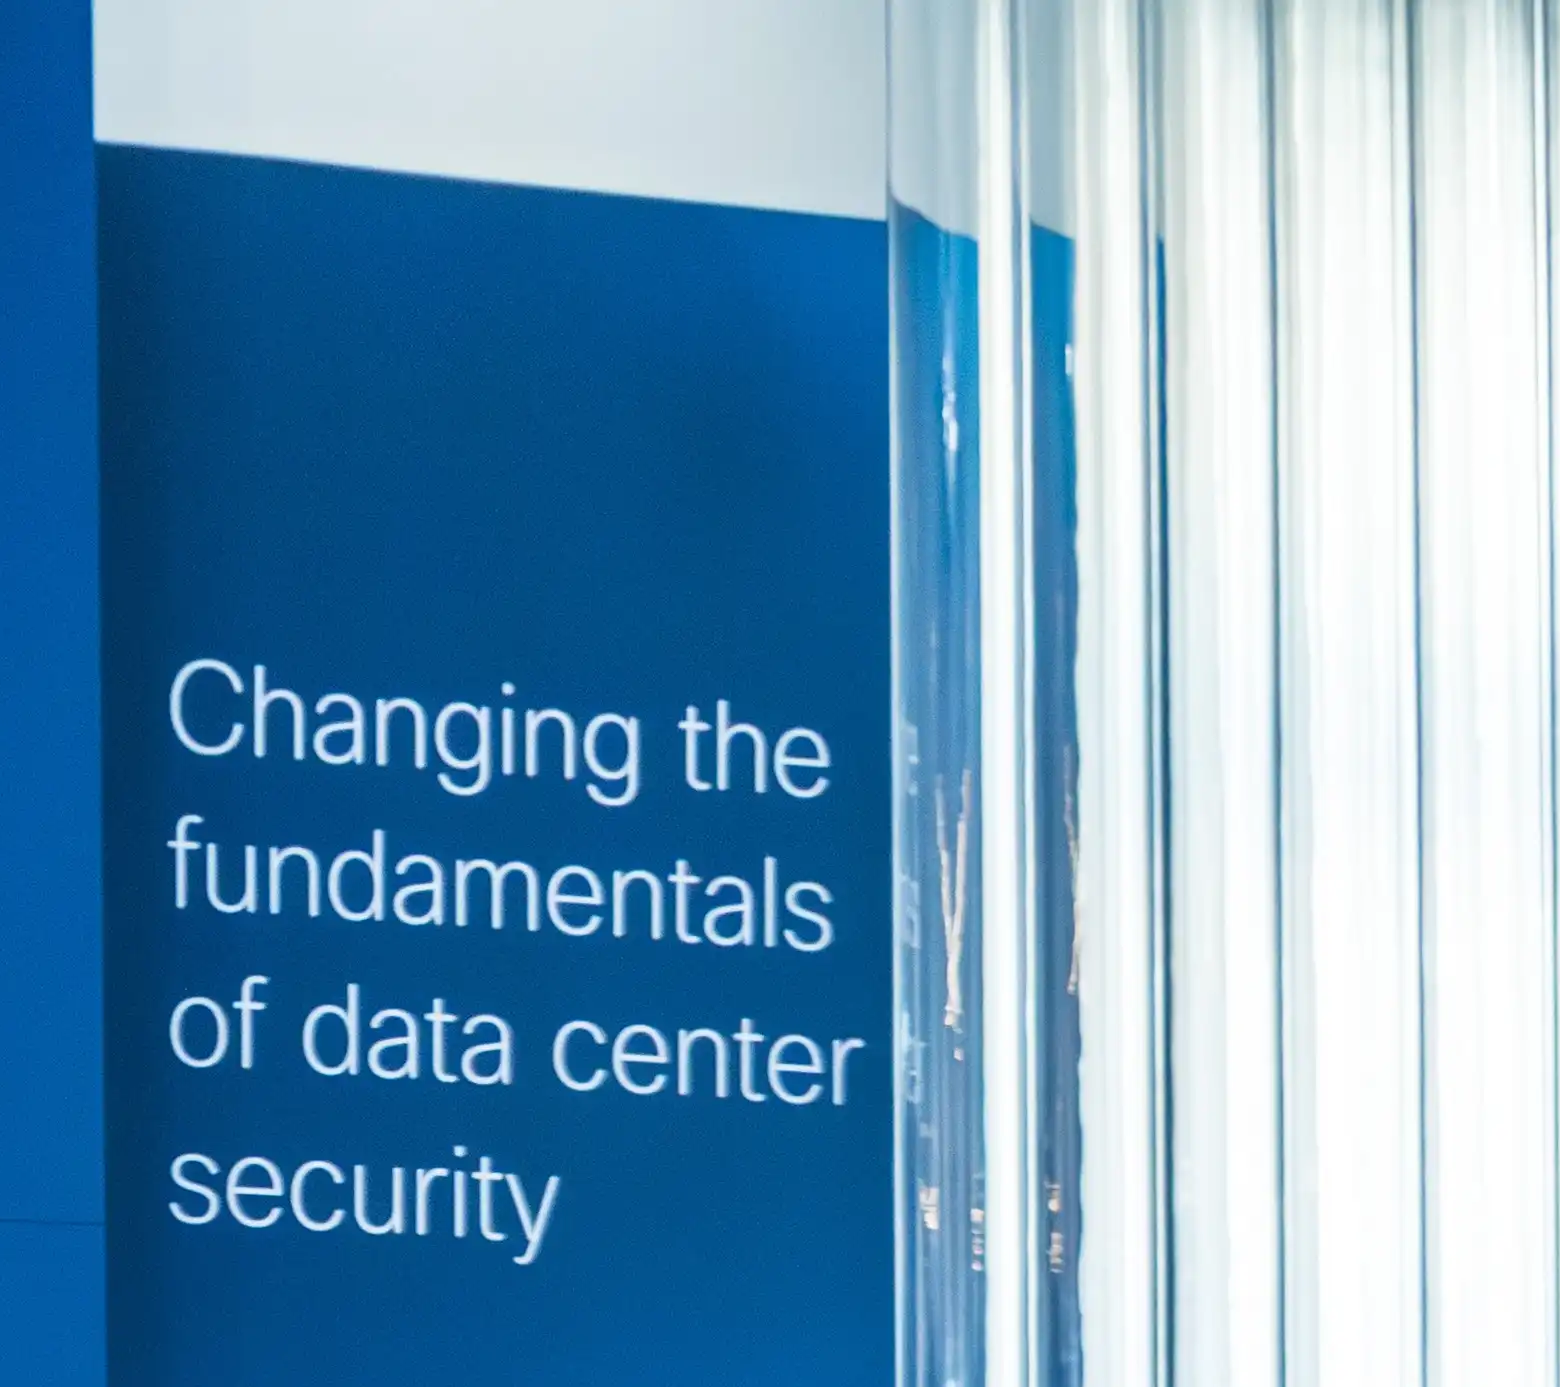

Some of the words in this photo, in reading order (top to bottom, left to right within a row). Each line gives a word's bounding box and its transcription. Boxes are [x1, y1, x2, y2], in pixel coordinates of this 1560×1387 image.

[170, 659, 639, 807] Changing
[678, 699, 830, 798] the
[167, 814, 832, 952] fundamentals
[170, 975, 268, 1069] of
[302, 983, 511, 1085] data
[553, 1018, 864, 1105] center
[169, 1145, 560, 1265] security
